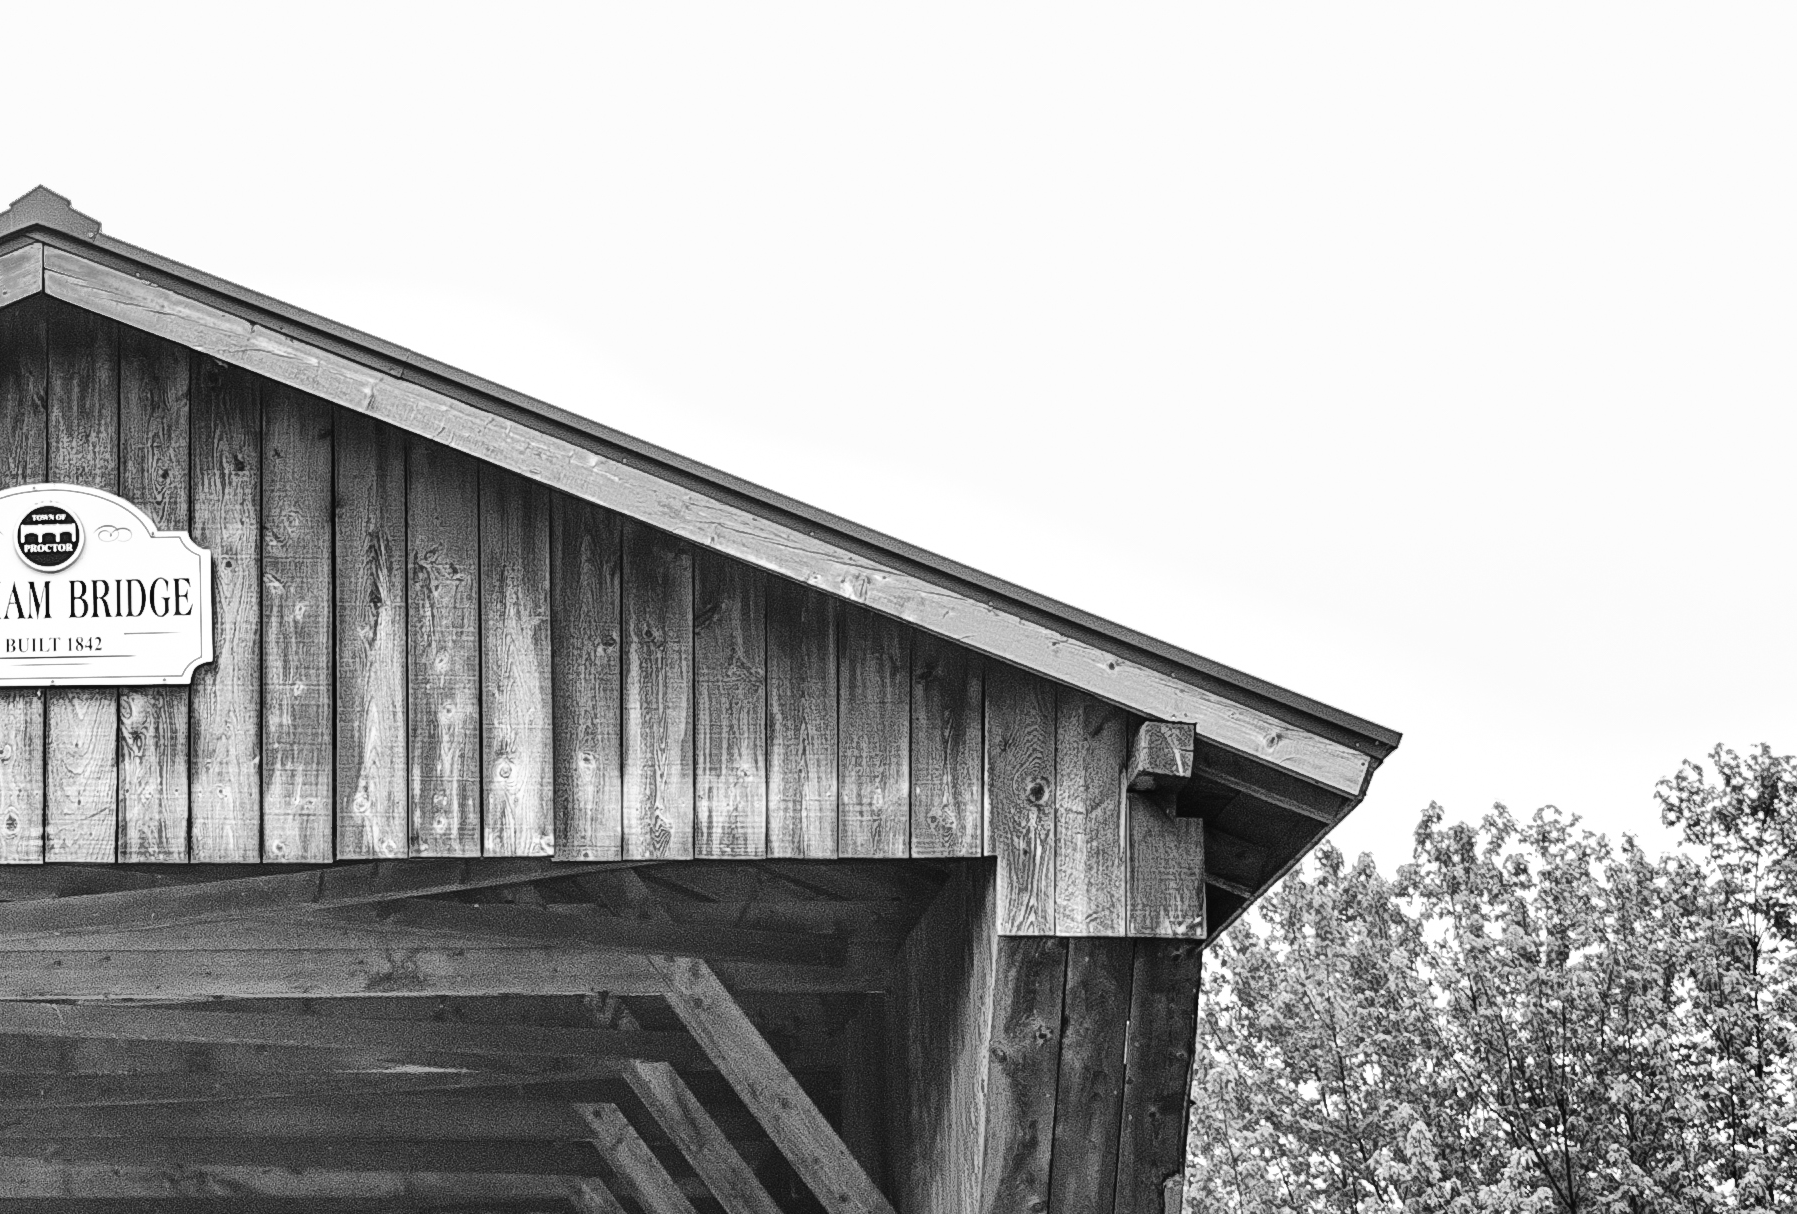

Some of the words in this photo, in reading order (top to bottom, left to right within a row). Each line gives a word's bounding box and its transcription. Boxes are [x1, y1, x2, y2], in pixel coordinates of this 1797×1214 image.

[55, 513, 67, 521] OF
[23, 543, 73, 553] PROCTOR
[68, 577, 193, 618] BRIDGE
[6, 637, 60, 653] BUILT
[68, 636, 102, 652] 1842
